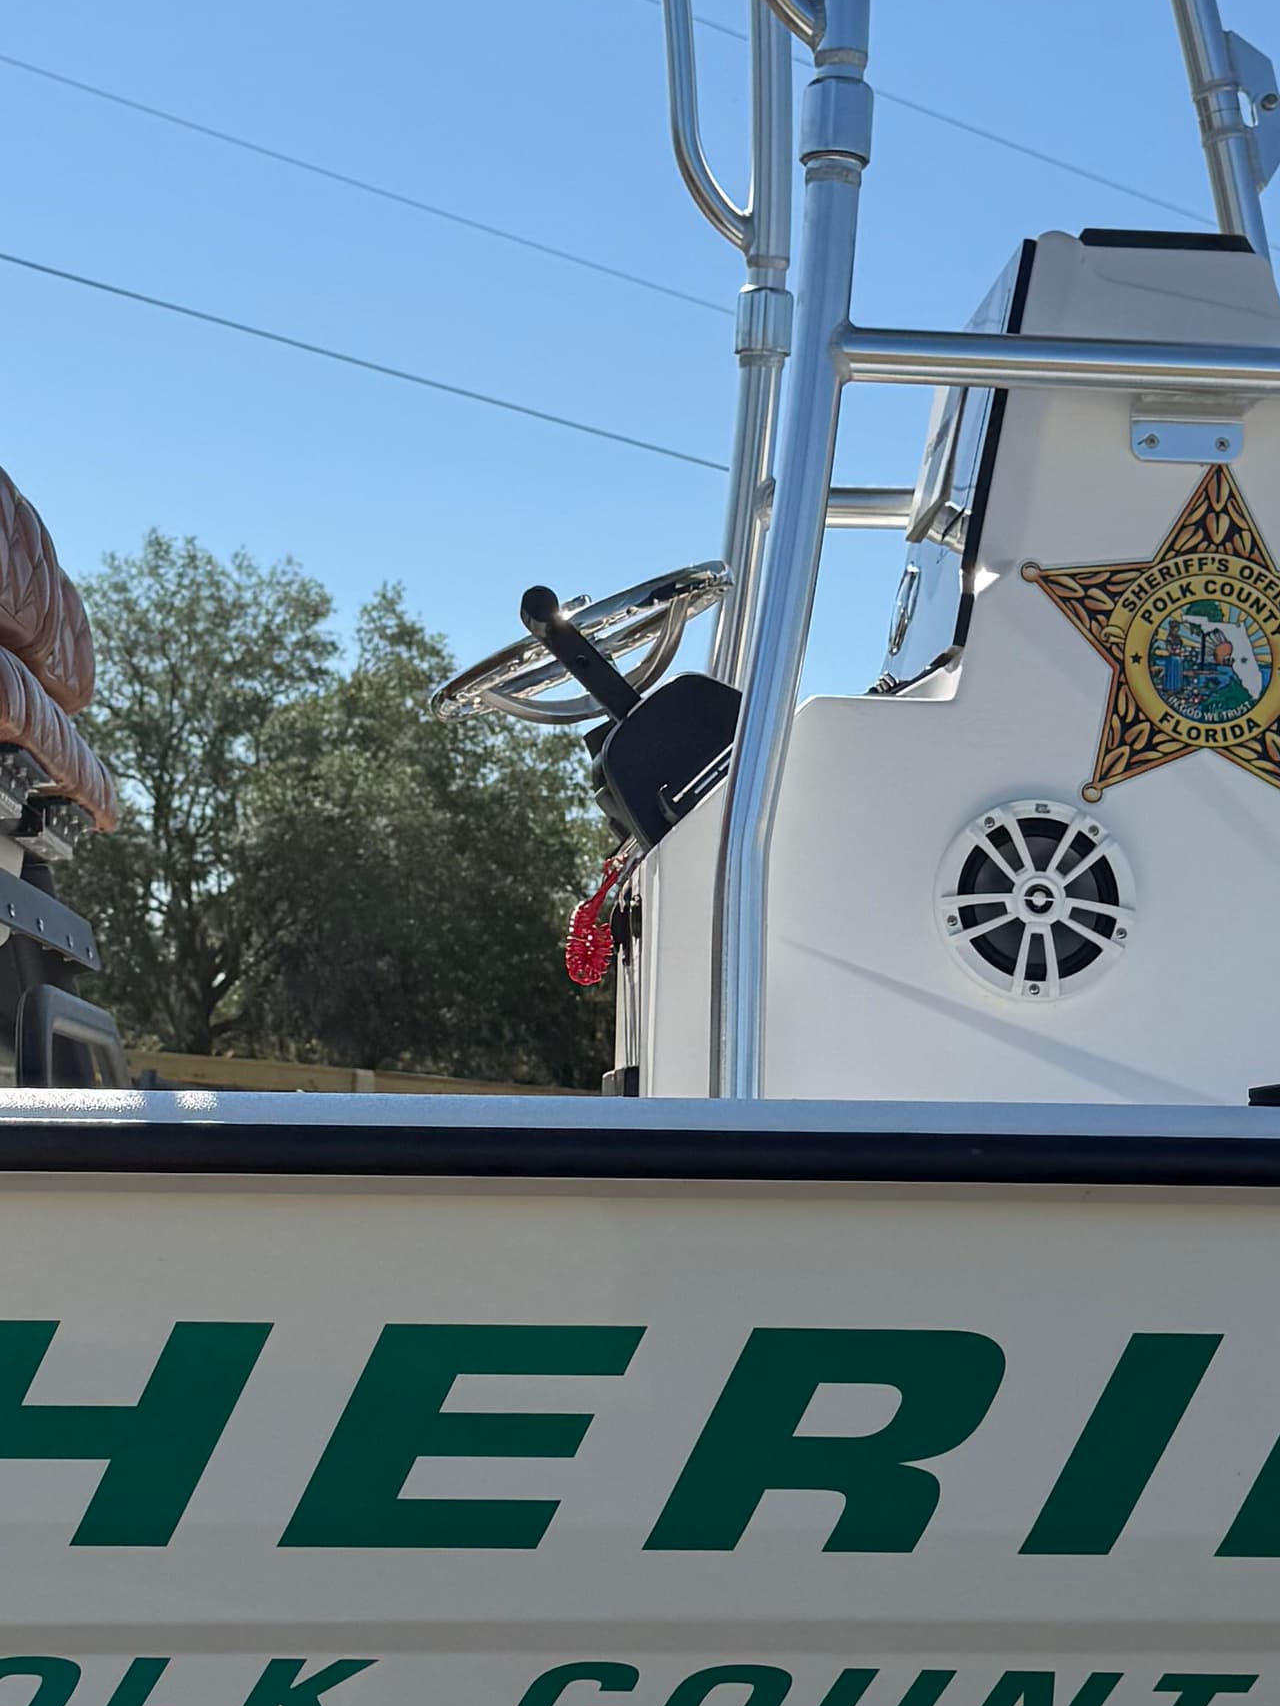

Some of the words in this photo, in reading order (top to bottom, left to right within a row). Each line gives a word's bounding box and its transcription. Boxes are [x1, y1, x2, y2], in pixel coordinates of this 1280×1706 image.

[1122, 556, 1230, 613] SHERIFF'S
[1140, 581, 1197, 626] POLK
[1157, 710, 1262, 743] FLORIDA
[1179, 702, 1201, 719] GOD
[1203, 712, 1220, 722] WE
[1222, 700, 1252, 720] TRUST
